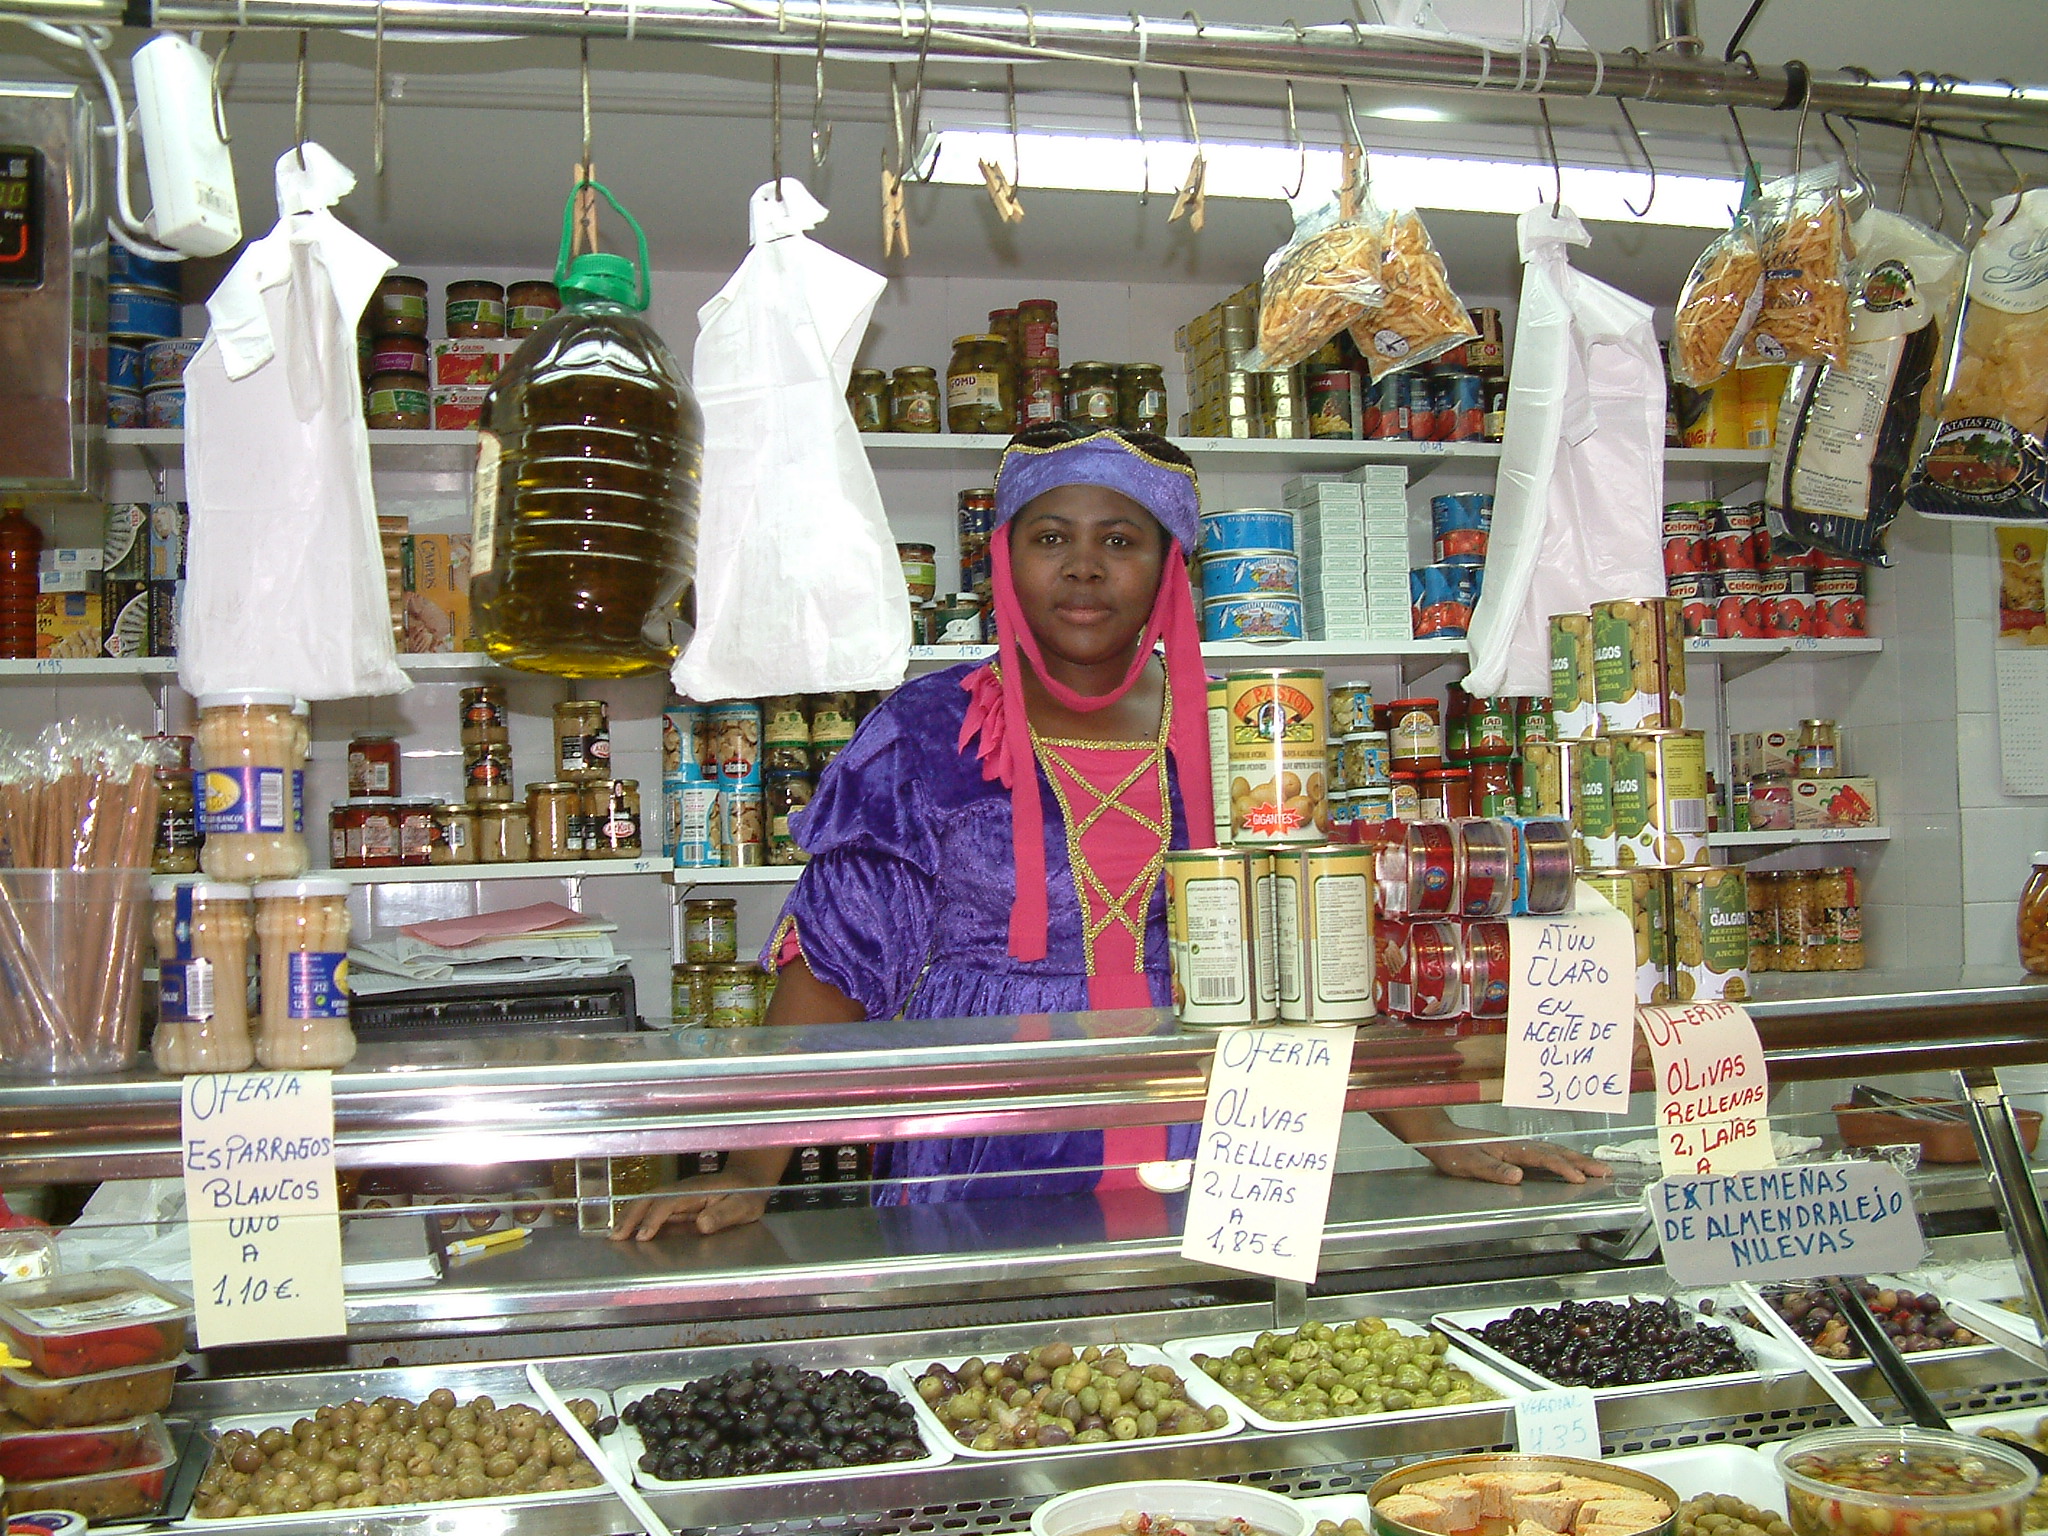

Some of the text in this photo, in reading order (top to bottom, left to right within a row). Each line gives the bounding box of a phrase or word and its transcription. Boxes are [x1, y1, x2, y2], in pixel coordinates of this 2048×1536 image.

[1252, 813, 1293, 825] GIGANTES
[1527, 956, 1609, 987] CLARO
[1537, 997, 1572, 1016] EN
[1523, 1014, 1618, 1042] ACEITE DE
[1222, 1030, 1331, 1073] OFERTA
[1540, 1046, 1595, 1067] OLIVA
[1667, 1054, 1747, 1096] OLIVAS
[1214, 1087, 1308, 1133] OLIVAS
[1663, 1085, 1764, 1125] RELLENAS
[1702, 1118, 1757, 1153] LATAS
[1208, 1131, 1328, 1171] RELLENAS
[1697, 1157, 1712, 1175] A
[202, 1178, 319, 1208] BLANCOS
[1230, 1174, 1297, 1204] LATAS
[1663, 1167, 1850, 1214] EXTREMEÑAS
[228, 1215, 280, 1238] UNO
[1229, 1208, 1244, 1225] A
[1664, 1215, 1696, 1242] DE
[242, 1244, 259, 1263] A
[1730, 1227, 1856, 1268] NUEVAS
